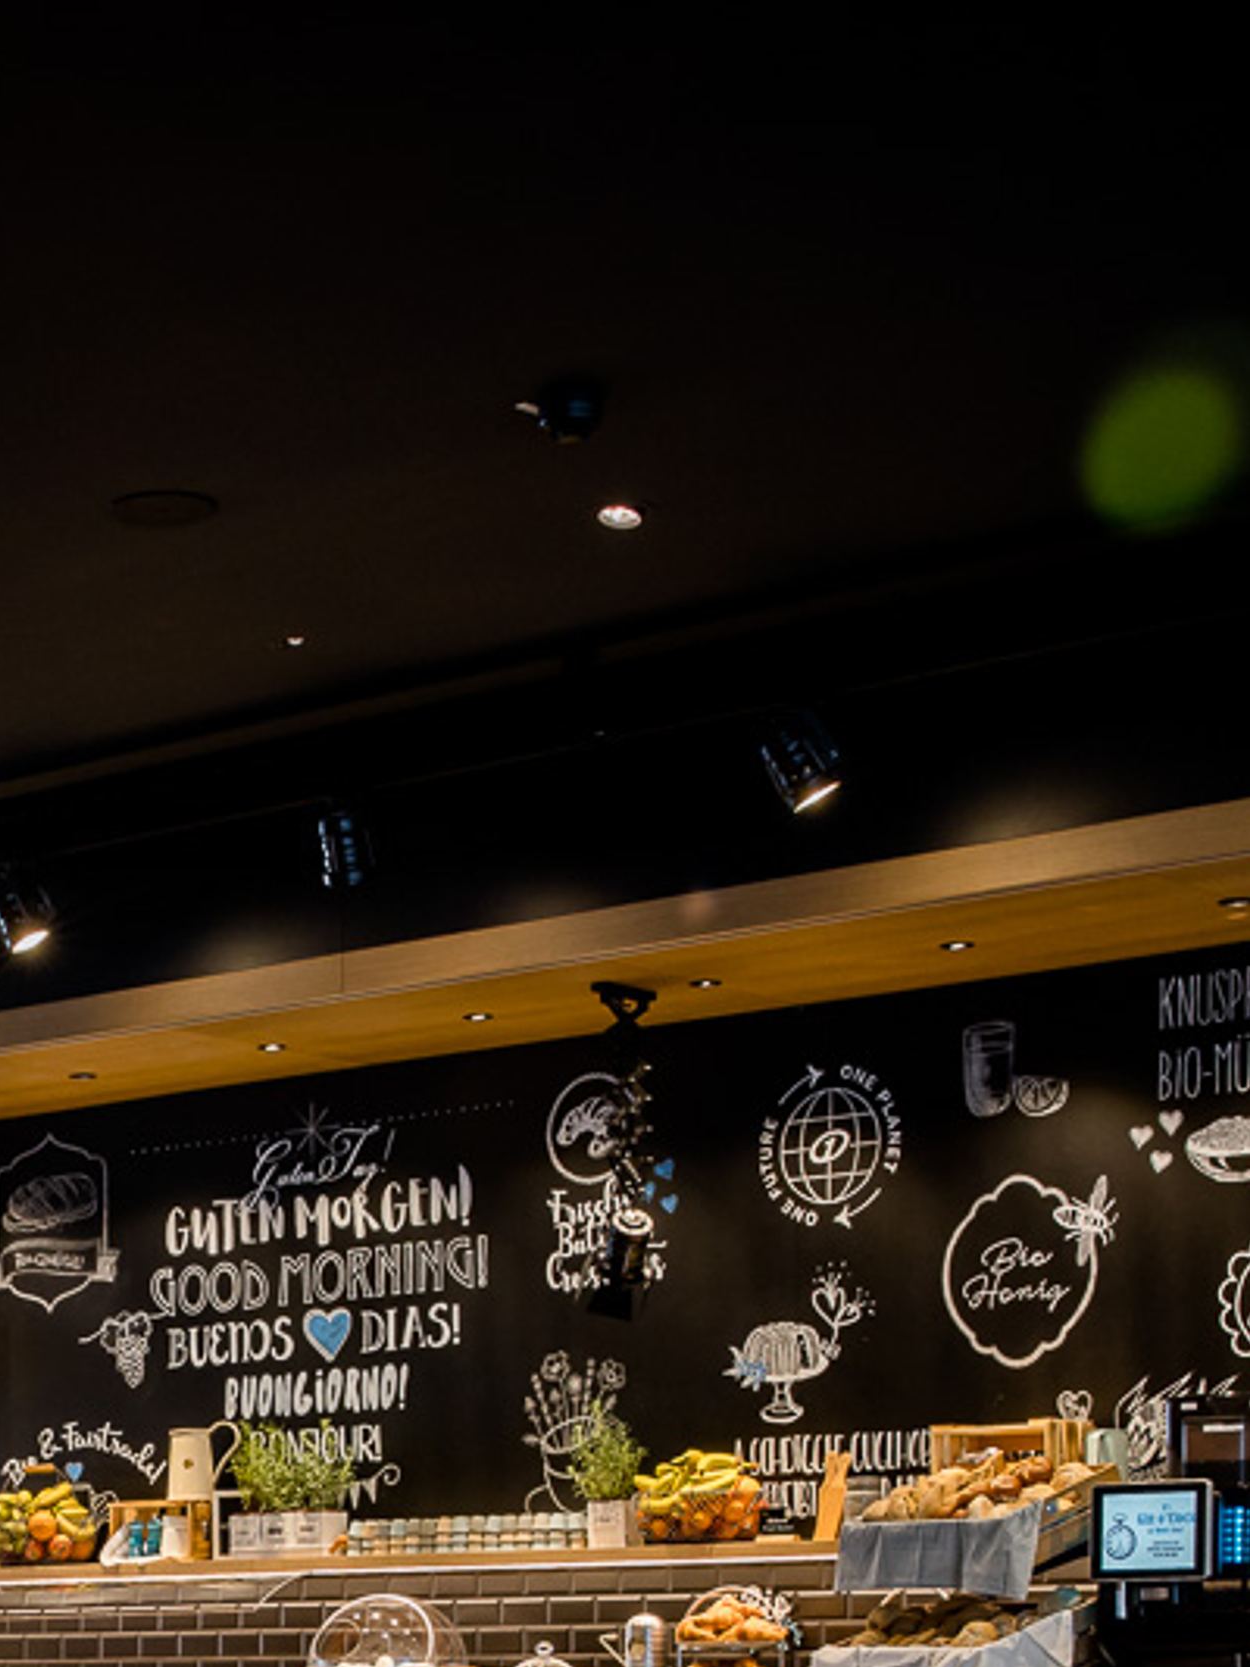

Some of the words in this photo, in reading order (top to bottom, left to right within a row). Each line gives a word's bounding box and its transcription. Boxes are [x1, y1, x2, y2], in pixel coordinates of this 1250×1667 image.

[840, 1065, 878, 1091] ONE
[875, 1088, 902, 1174] PLANET
[758, 1116, 782, 1201] FUTURE
[164, 1199, 285, 1257] GUTEN
[294, 1163, 473, 1247] MORGEN!
[780, 1198, 819, 1227] ONE
[150, 1260, 270, 1318] GOOD
[277, 1234, 489, 1307] MORNING!
[961, 1272, 1072, 1313] Honig
[980, 1236, 1054, 1275] Bio
[166, 1315, 296, 1370] BUENOS
[359, 1302, 462, 1355] DIAS!
